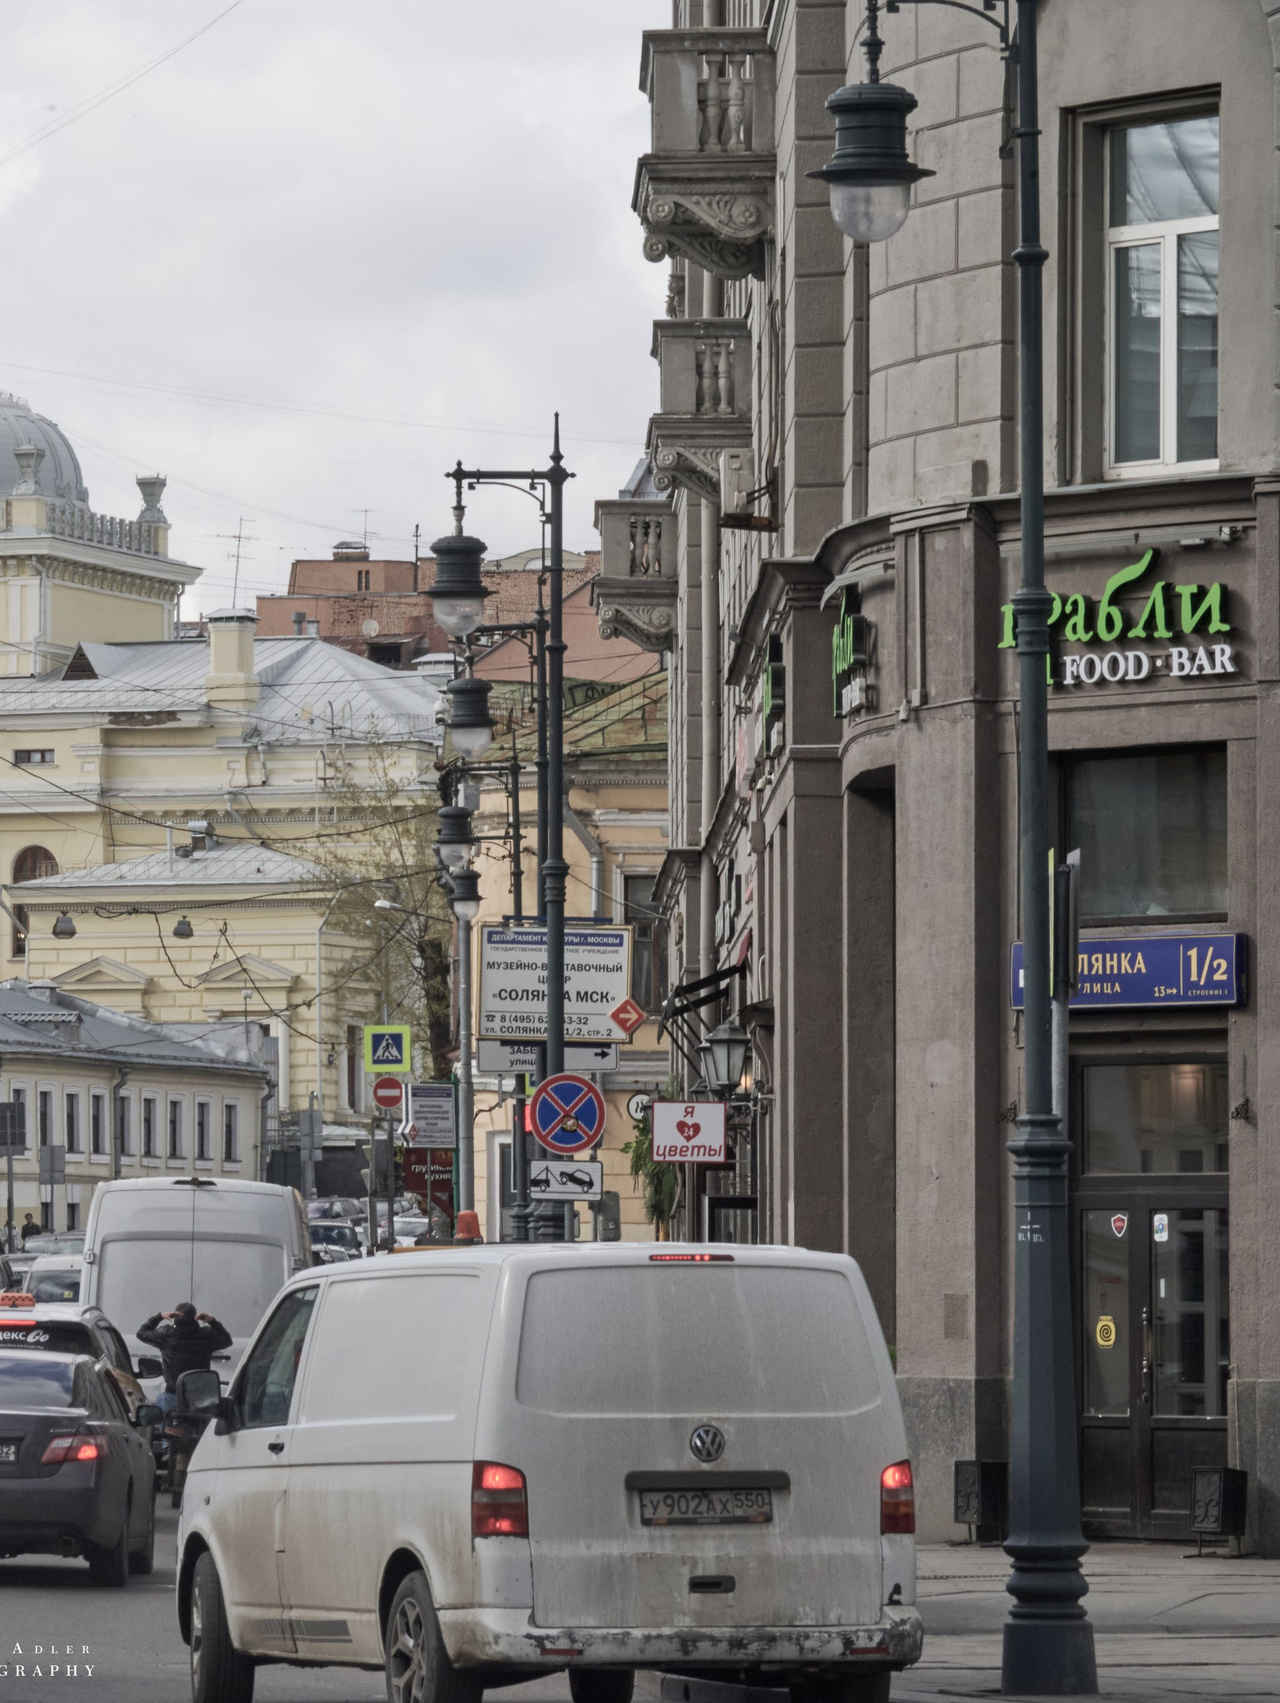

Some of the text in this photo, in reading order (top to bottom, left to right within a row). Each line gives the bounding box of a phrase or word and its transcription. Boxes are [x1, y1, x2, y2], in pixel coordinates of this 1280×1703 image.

[1063, 644, 1235, 685] FOOD BAR
[491, 934, 542, 942] ДЕПАРТАМЕНТ
[486, 960, 623, 973] МУЗЕЙНО-ВТАВОЧНЫЙ
[1077, 946, 1228, 986] ЛЯНКА 1/2
[1078, 981, 1122, 995] ЛИЦА
[1154, 986, 1166, 997] 13
[492, 988, 616, 1003] «СОЛЯНА МСК»
[500, 1014, 507, 1023] 8
[508, 1014, 536, 1024] (495)
[606, 1029, 613, 1037] 2
[682, 1127, 694, 1136] 24
[26, 1329, 50, 1343] Go
[734, 1492, 765, 1509] 550
